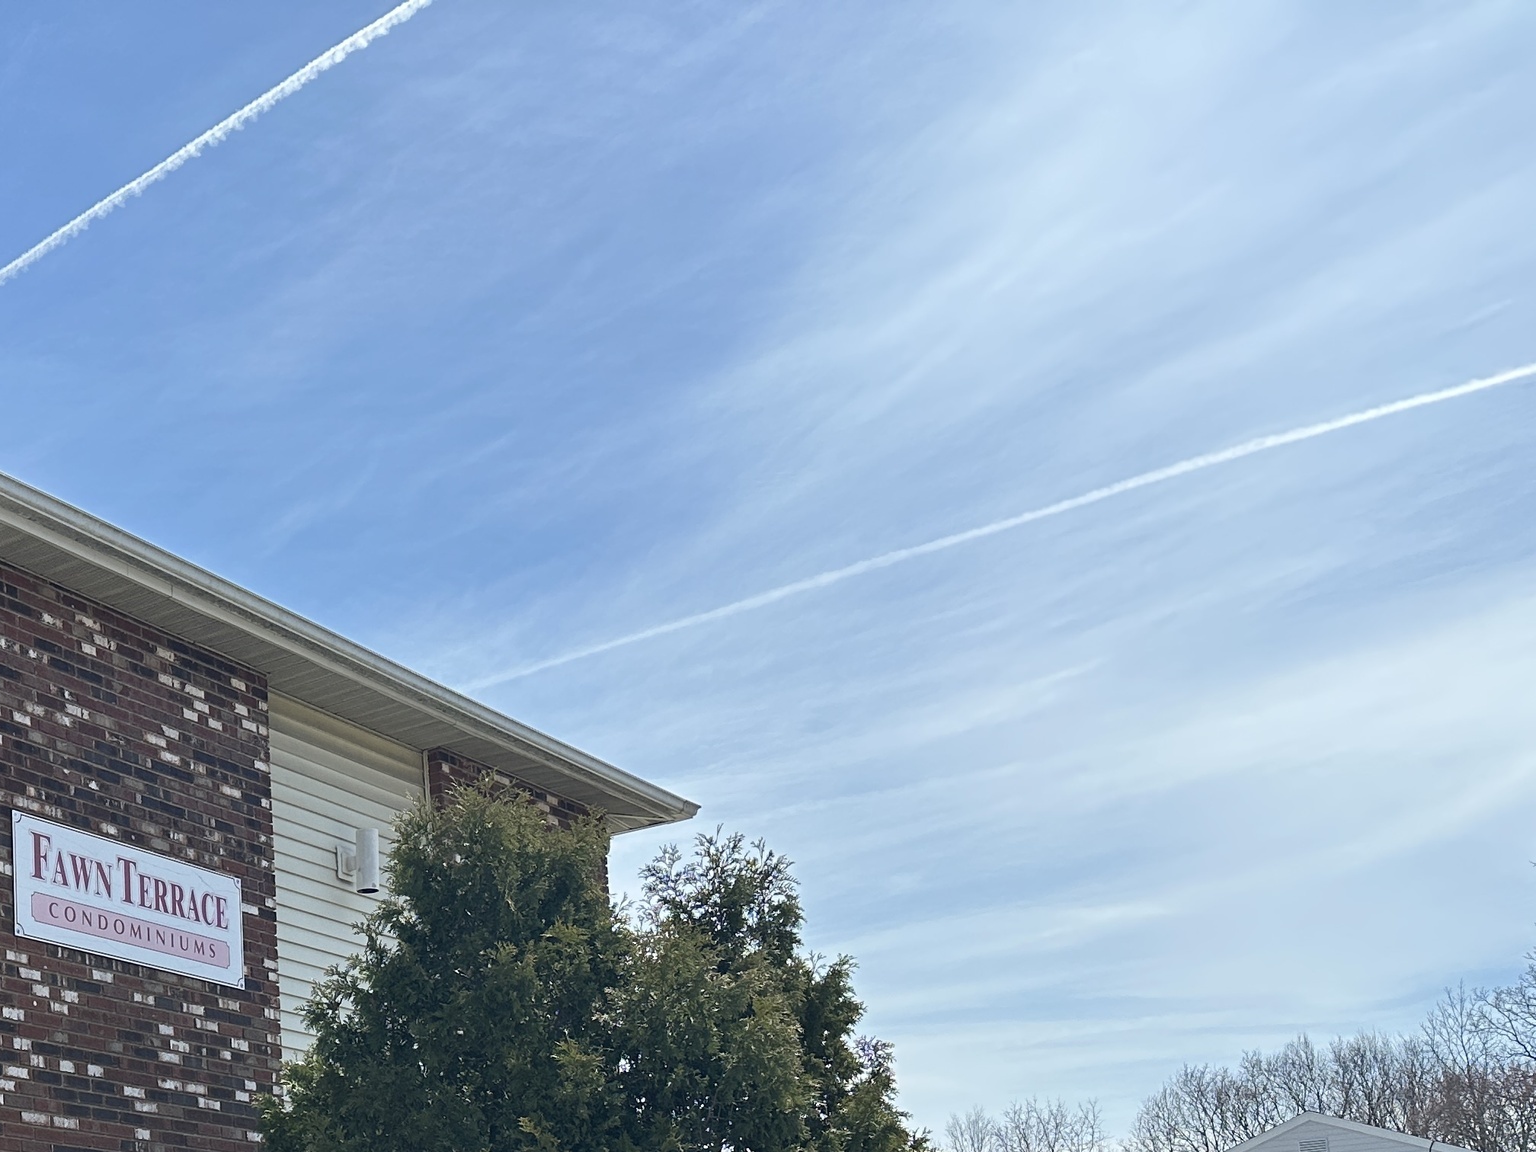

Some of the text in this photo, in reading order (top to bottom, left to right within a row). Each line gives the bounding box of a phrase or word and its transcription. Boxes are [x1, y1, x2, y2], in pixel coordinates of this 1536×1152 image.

[29, 830, 230, 931] FAWN TERRACE
[48, 901, 217, 960] CONDOMINIUMS
